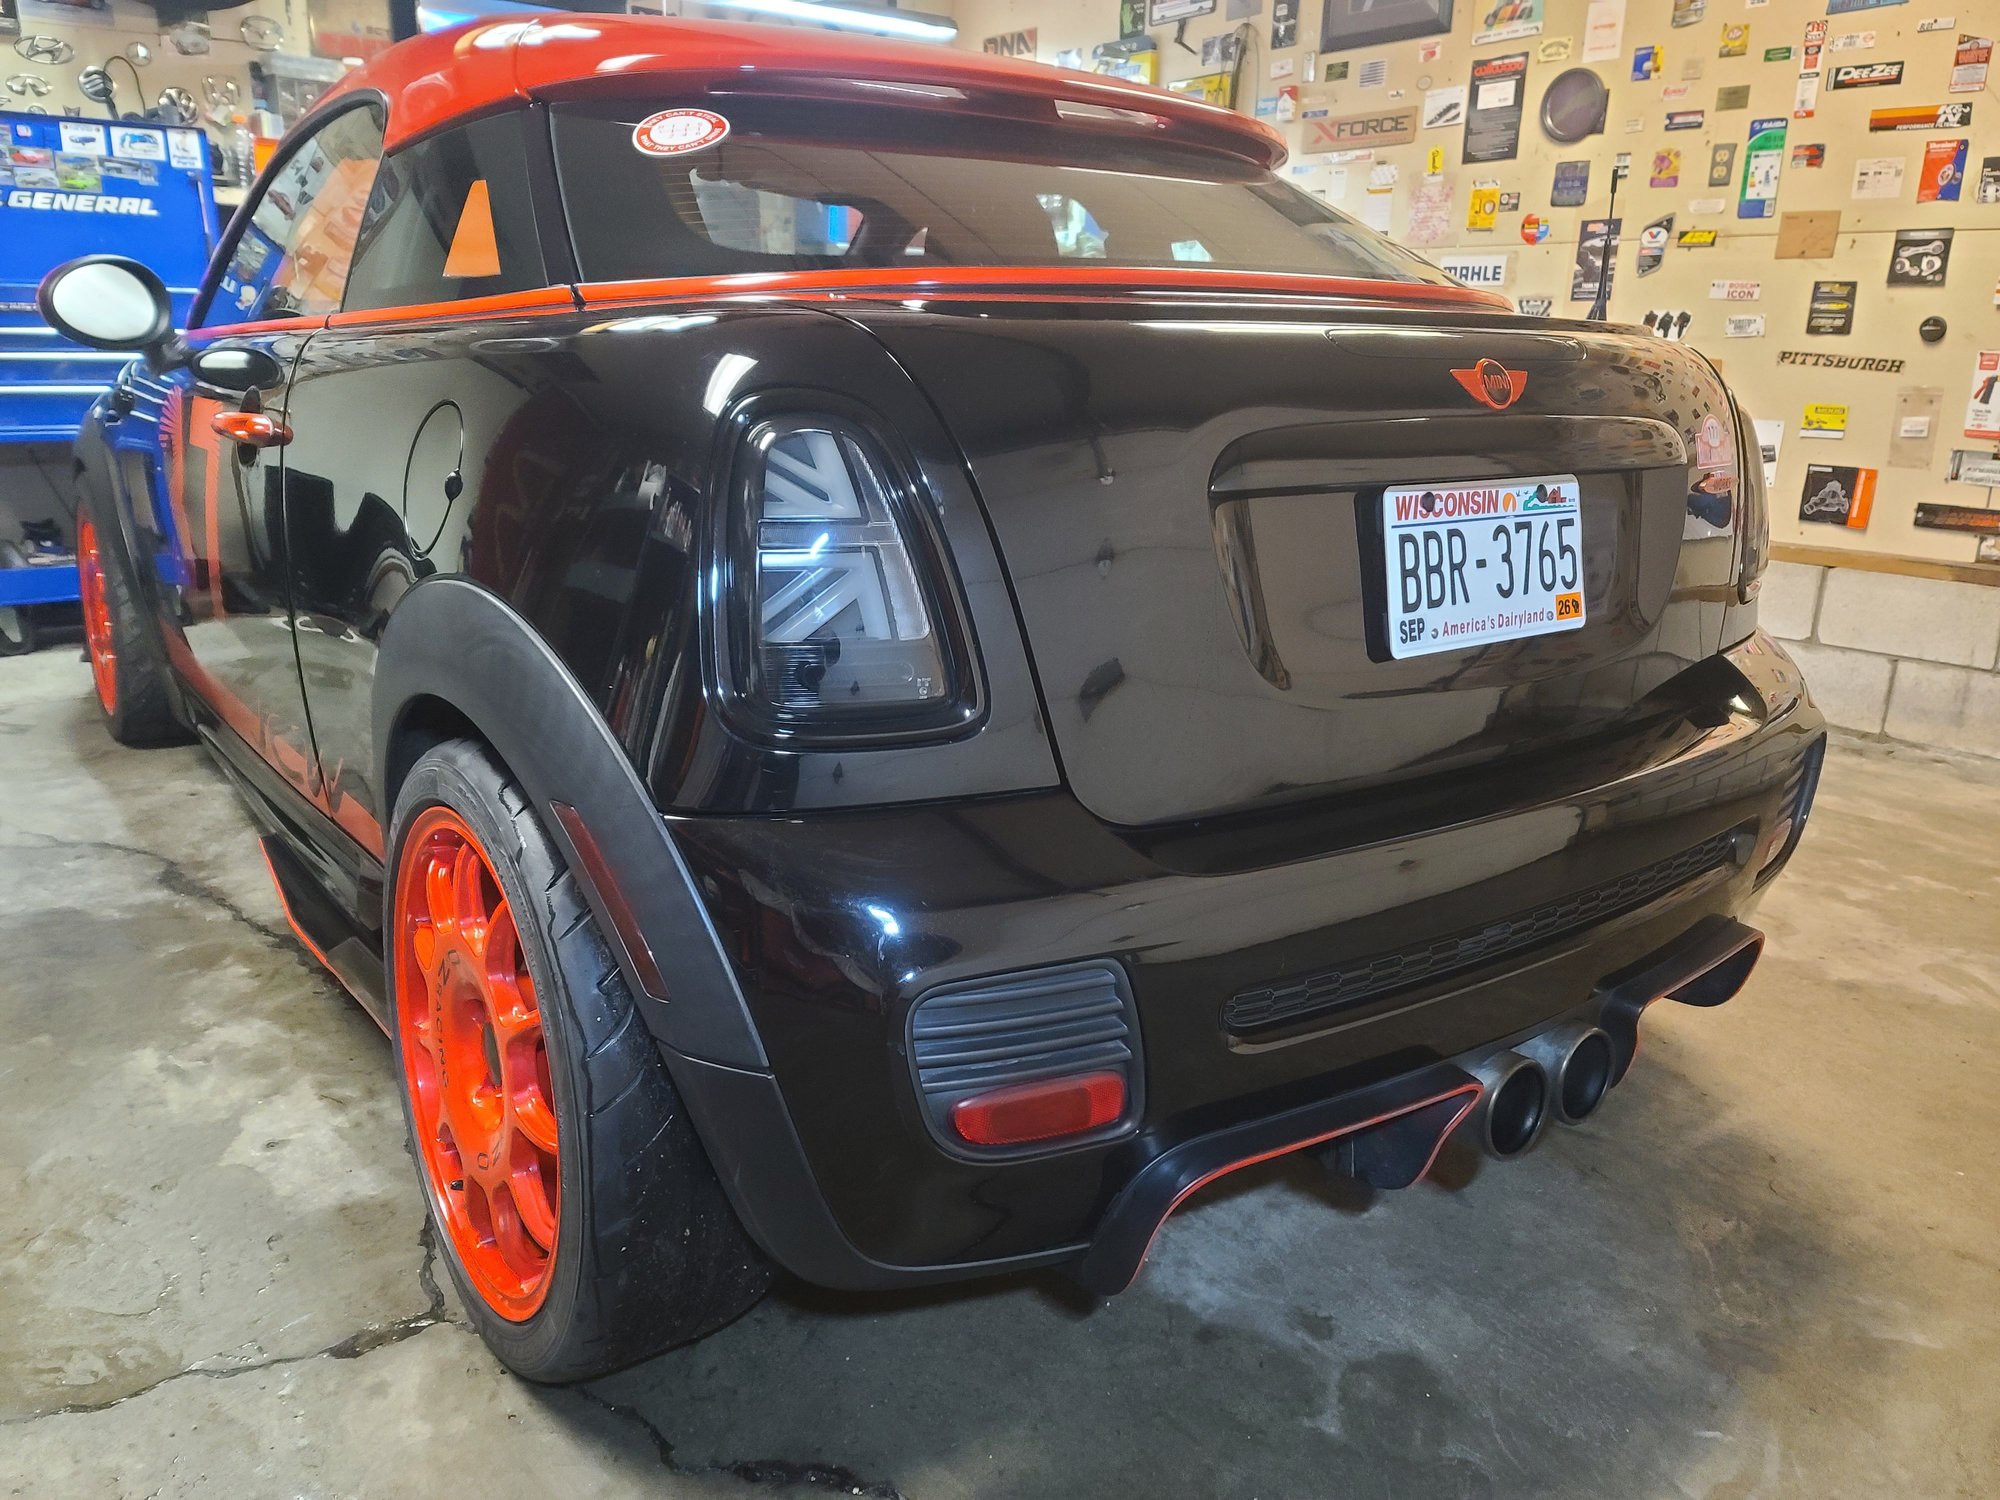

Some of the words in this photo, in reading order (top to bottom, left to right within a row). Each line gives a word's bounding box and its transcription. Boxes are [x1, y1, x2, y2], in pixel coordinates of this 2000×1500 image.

[8, 190, 160, 216] GENERAL
[1727, 290, 1755, 299] ICON
[1728, 282, 1757, 290] BOSCH
[1779, 351, 1905, 373] PITTSBURGH
[1398, 518, 1578, 614] BBR-3765
[1558, 599, 1571, 615] 26
[1399, 618, 1426, 644] SEP
[1442, 615, 1496, 638] America's
[1497, 608, 1545, 630] Dairyland
